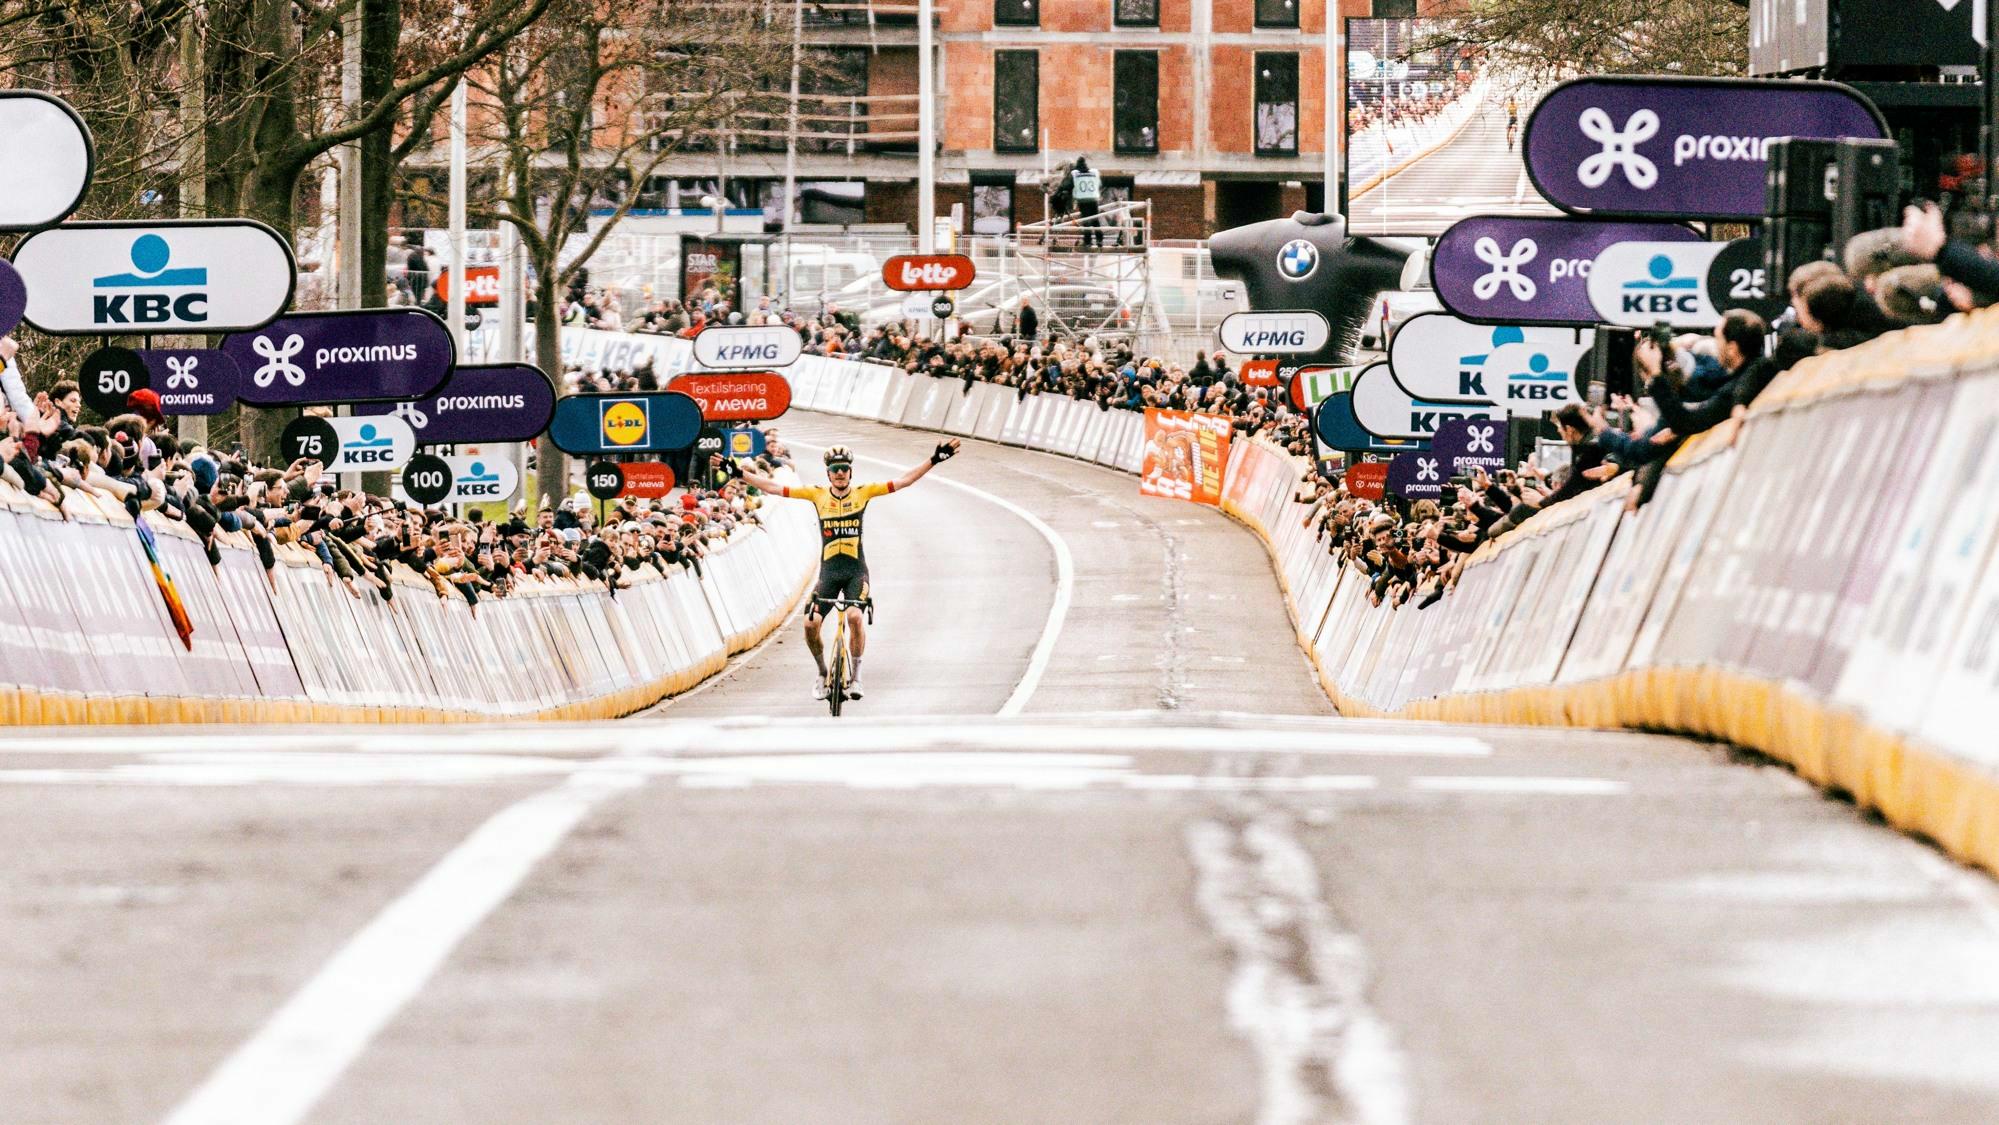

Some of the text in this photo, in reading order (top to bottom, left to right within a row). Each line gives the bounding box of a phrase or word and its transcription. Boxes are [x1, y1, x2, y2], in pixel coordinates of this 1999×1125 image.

[1674, 134, 1770, 167] proxi
[1080, 180, 1096, 193] 03
[687, 253, 717, 266] STAR
[902, 261, 957, 285] lotto
[1729, 268, 1766, 299] 25
[93, 292, 208, 324] KBC
[934, 302, 952, 311] 300
[1622, 295, 1698, 314] KBC
[1242, 330, 1306, 347] KPMG
[315, 343, 417, 369] proximus
[716, 343, 779, 360] KPMG
[98, 370, 131, 394] 50
[689, 381, 767, 395] Textilsharing
[160, 393, 214, 405] roximus
[1507, 384, 1568, 401] KBC
[436, 394, 525, 415] proximus
[296, 435, 323, 455] 75
[698, 437, 722, 449] 200
[343, 449, 394, 463] KBC
[1453, 456, 1505, 467] proximus
[410, 471, 443, 489] 100
[592, 473, 618, 488] 150
[456, 483, 500, 496] KBC
[1405, 483, 1442, 495] proxim
[823, 518, 860, 529] JUMBO
